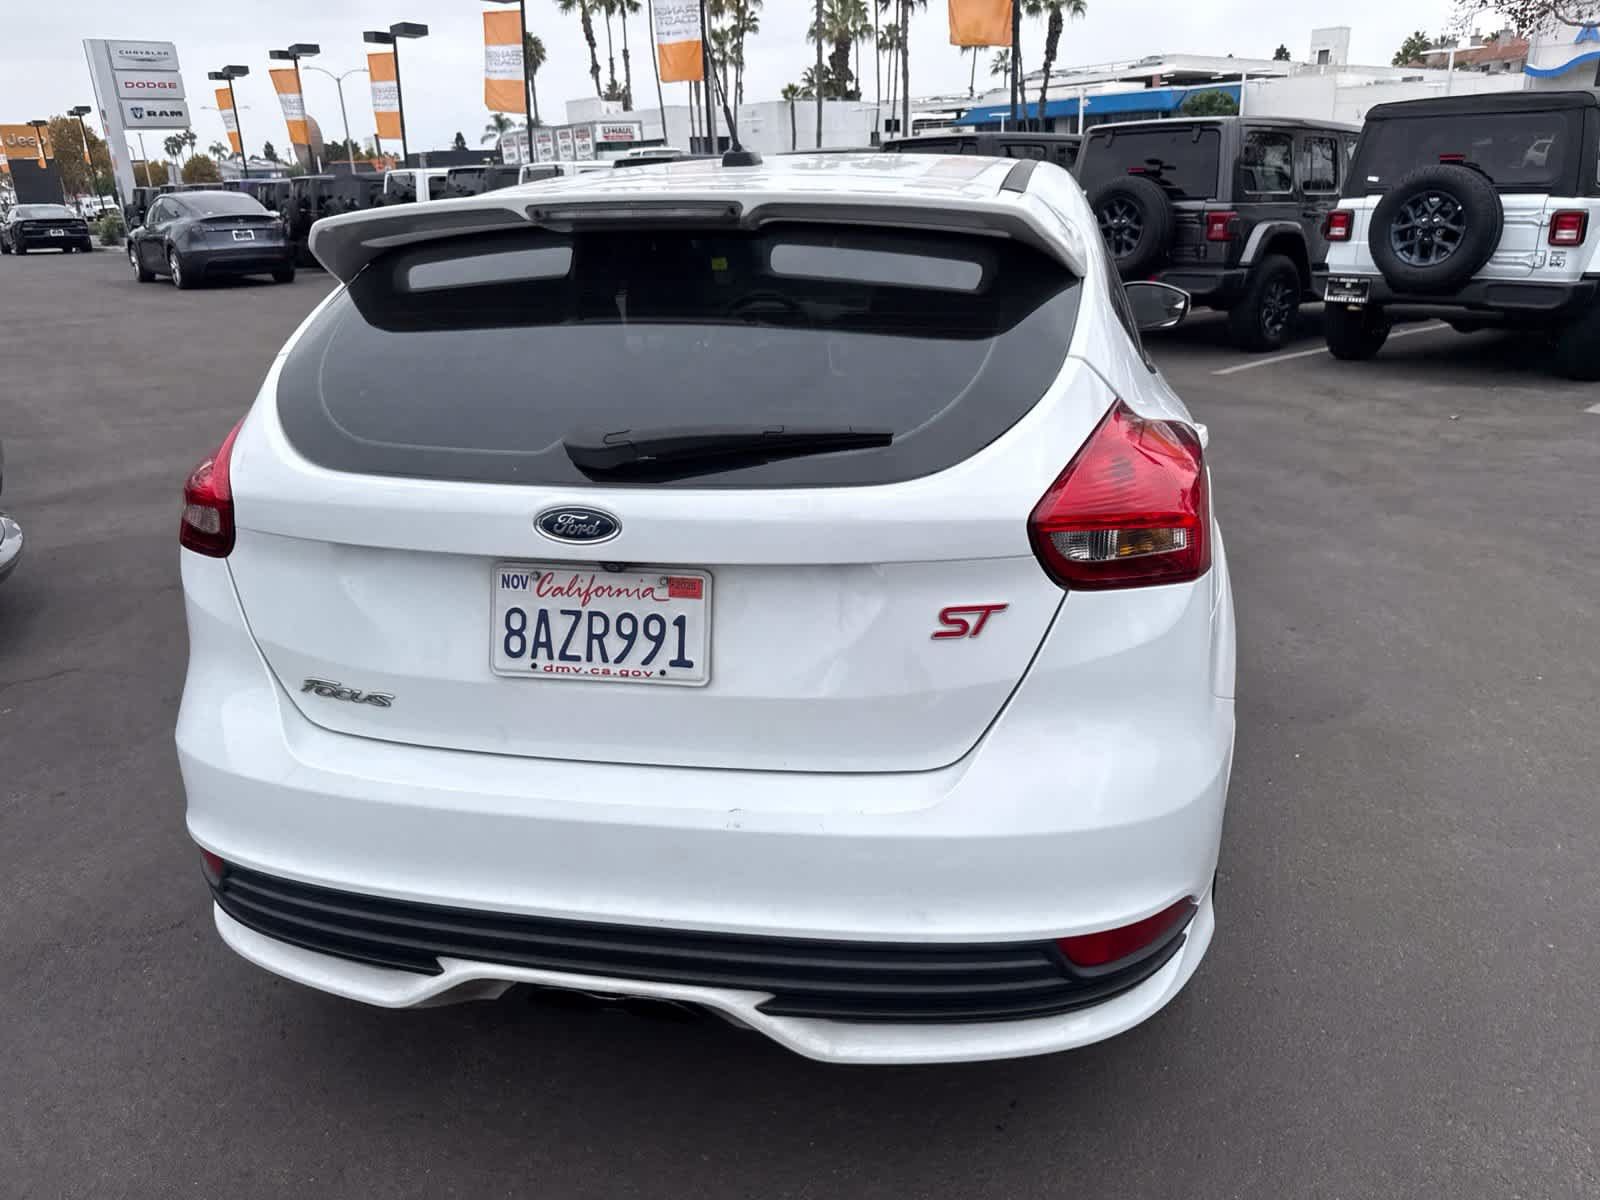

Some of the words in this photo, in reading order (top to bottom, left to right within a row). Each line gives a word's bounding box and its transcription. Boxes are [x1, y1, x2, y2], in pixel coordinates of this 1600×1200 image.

[124, 81, 177, 89] DODGE
[553, 513, 601, 535] Ford
[501, 574, 529, 590] NOV
[536, 572, 671, 607] California
[930, 602, 1010, 640] ST
[504, 607, 694, 668] 8AZR991
[543, 664, 654, 678] dmv.ca.gov
